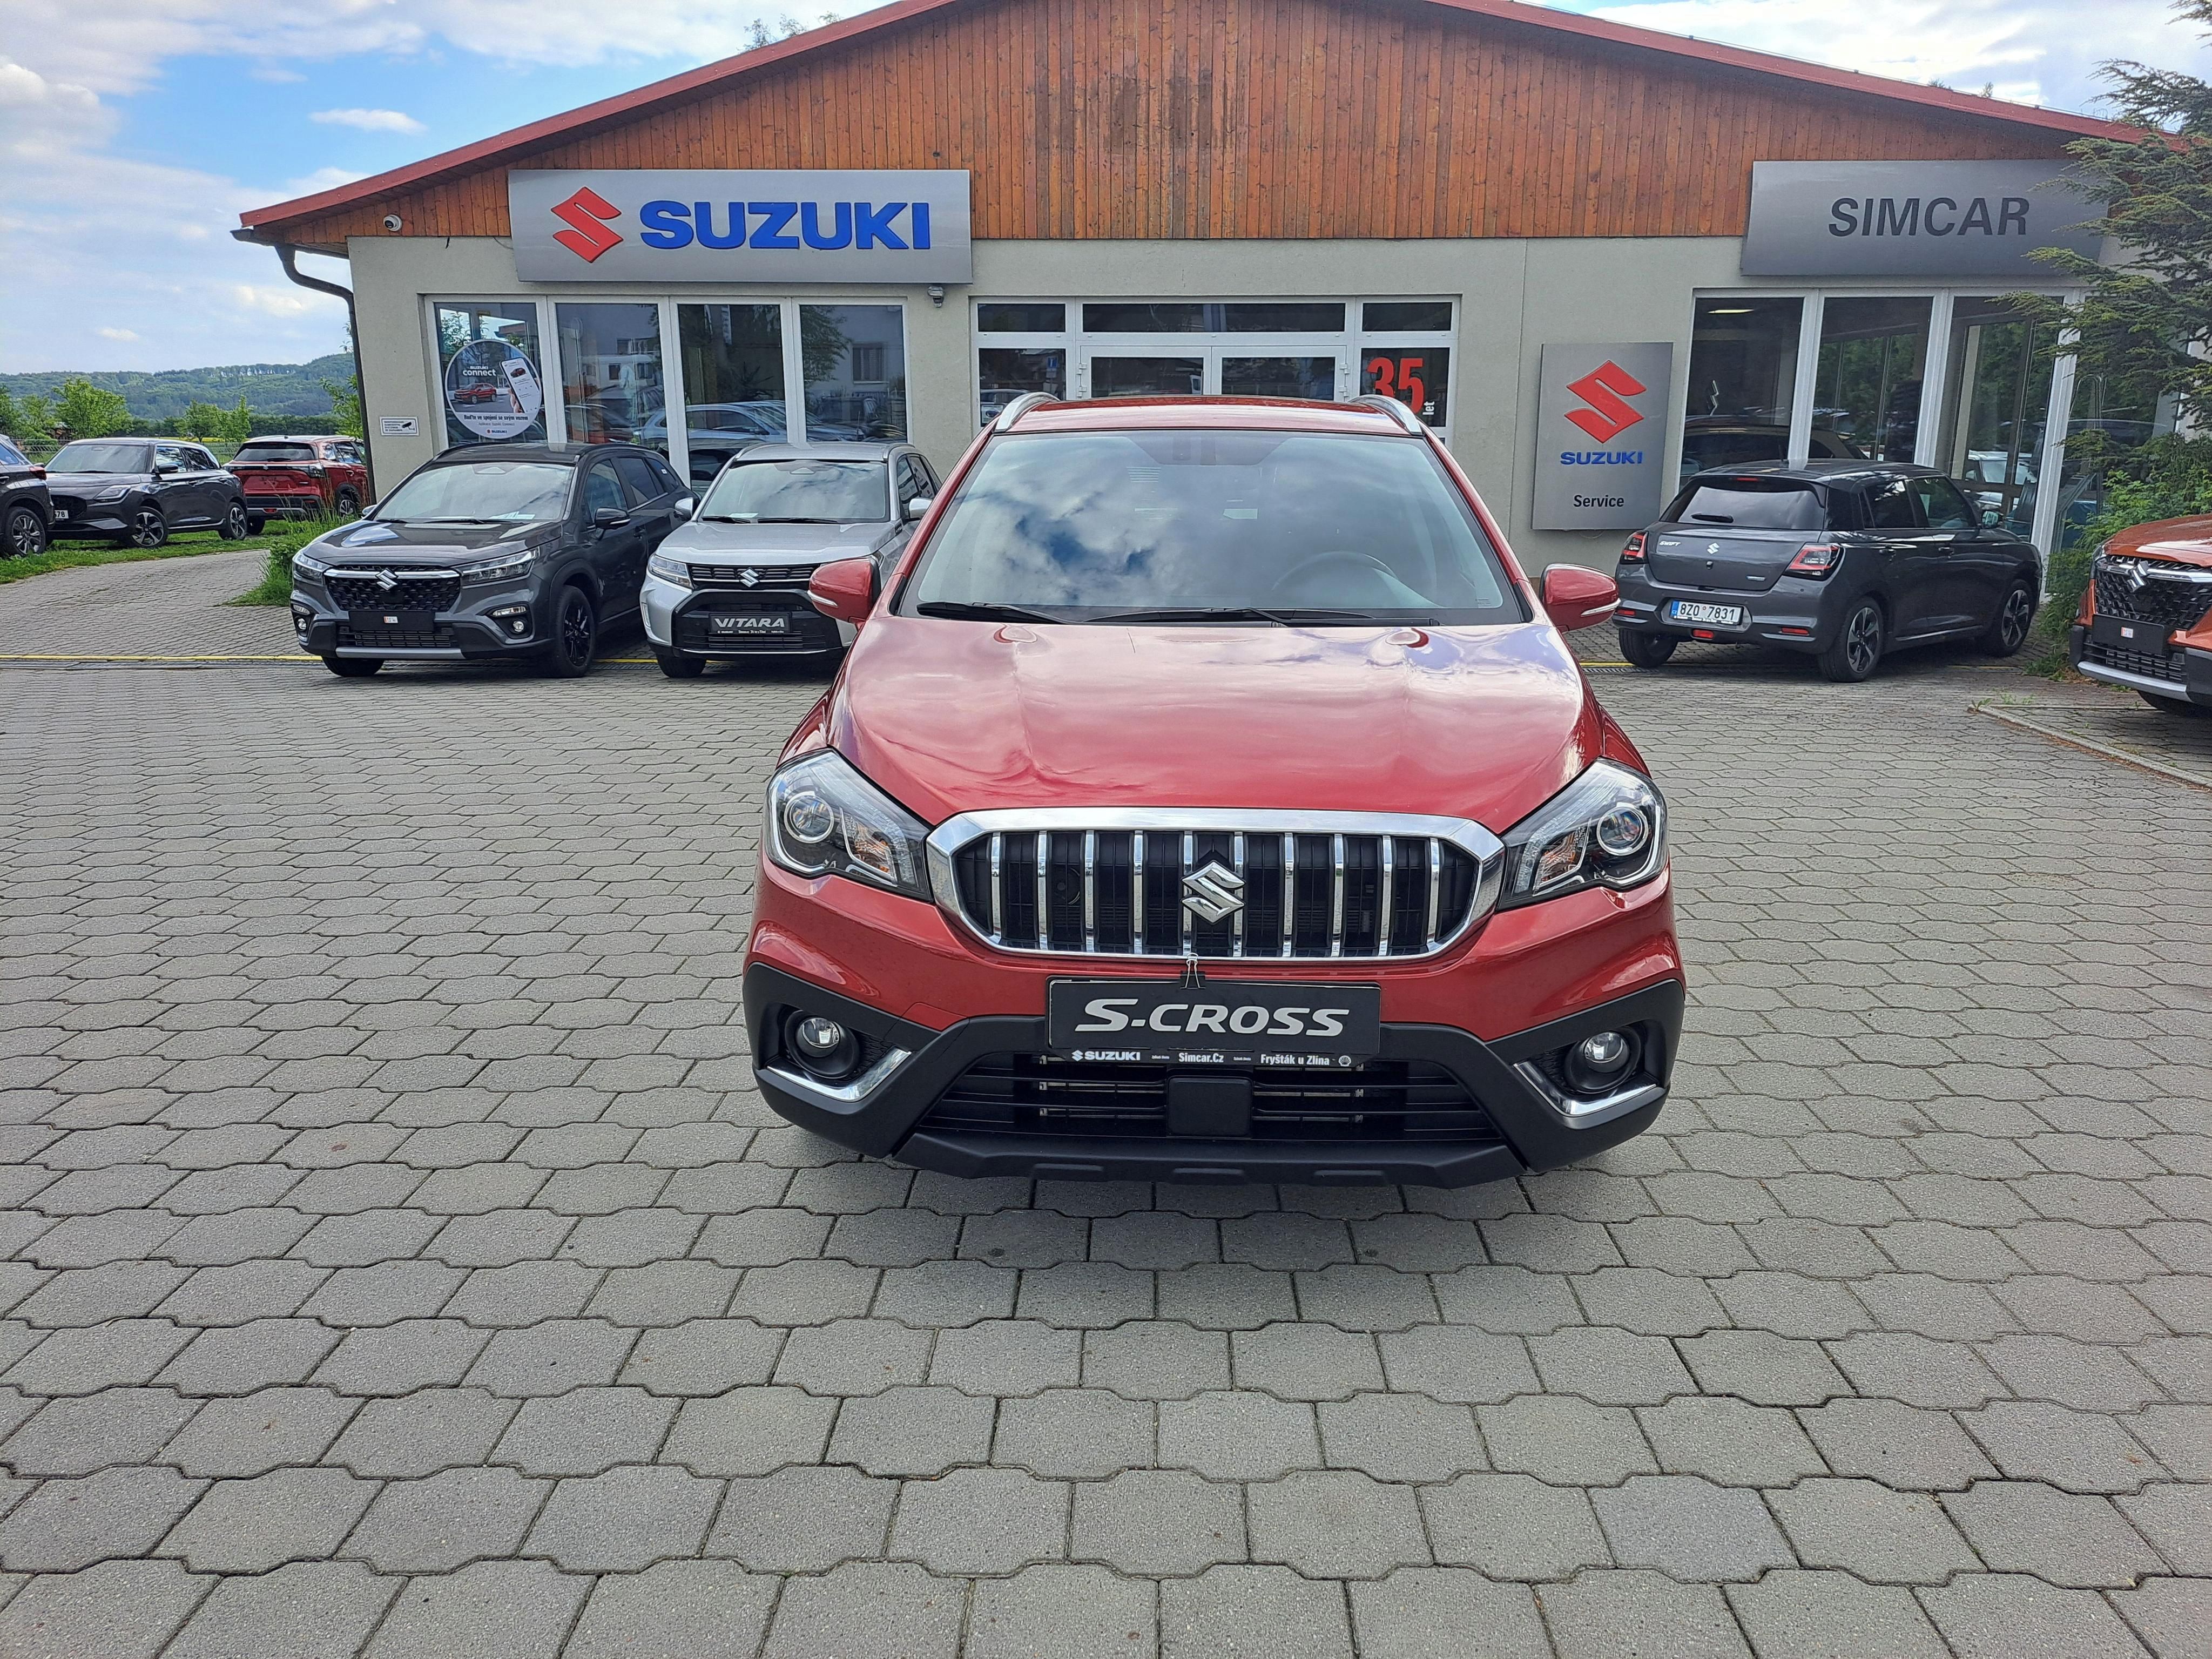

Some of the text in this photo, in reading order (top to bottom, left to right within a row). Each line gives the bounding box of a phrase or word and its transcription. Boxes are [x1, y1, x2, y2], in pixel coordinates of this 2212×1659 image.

[640, 199, 930, 250] SUZUKI
[1828, 197, 2030, 237] SIMCAR
[1366, 357, 1424, 414] 35
[1422, 401, 1435, 415] let
[1560, 451, 1643, 465] SUZUKI
[1573, 494, 1624, 508] Service
[1680, 604, 1735, 621] 8Z0 7831
[714, 618, 785, 627] VITARA
[1074, 998, 1350, 1037] S-CROSS
[1084, 1051, 1330, 1065] SUZUKI Simcar.Cz Fryšták u Zlína
